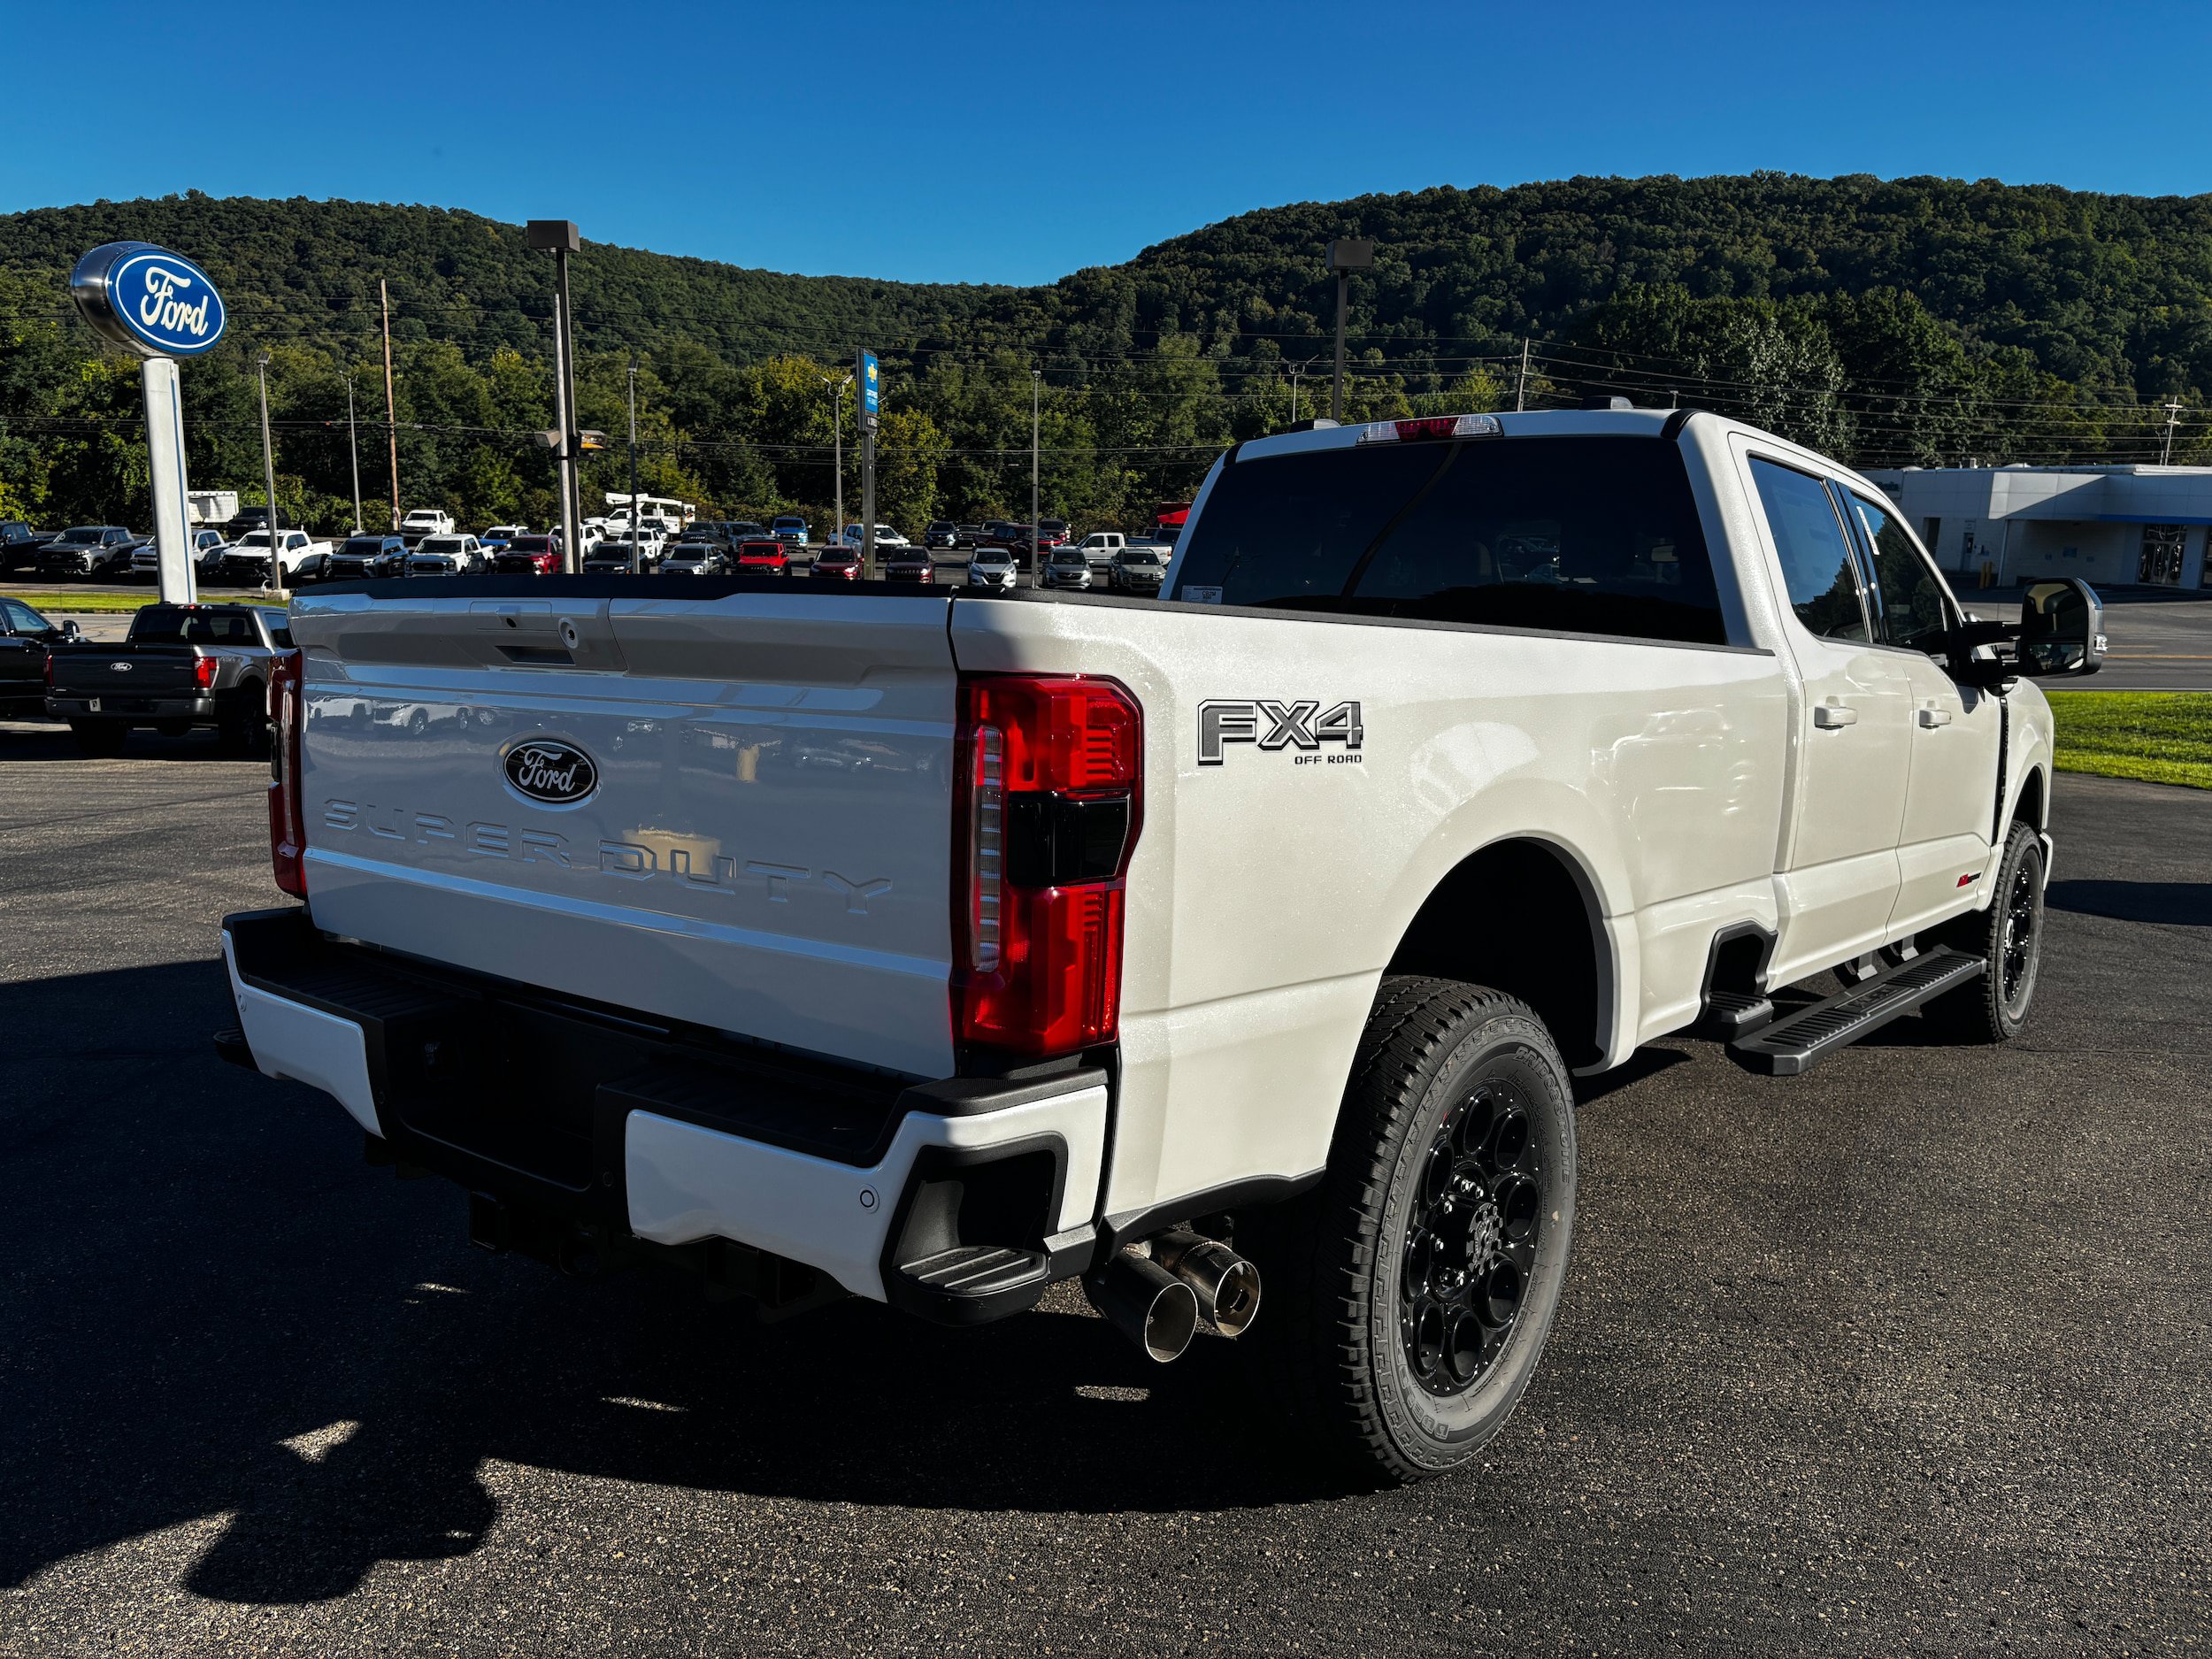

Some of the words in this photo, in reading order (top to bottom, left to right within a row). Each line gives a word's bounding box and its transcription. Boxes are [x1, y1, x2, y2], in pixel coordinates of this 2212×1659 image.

[140, 265, 210, 336] Ford
[1197, 698, 1363, 766] FX4
[1294, 755, 1323, 764] OFF
[1327, 754, 1363, 764] ROAD
[518, 748, 576, 794] Ford
[324, 797, 572, 870] SUPER
[598, 838, 895, 915] DUTY
[1512, 1046, 1572, 1184] BRIDGESTONE
